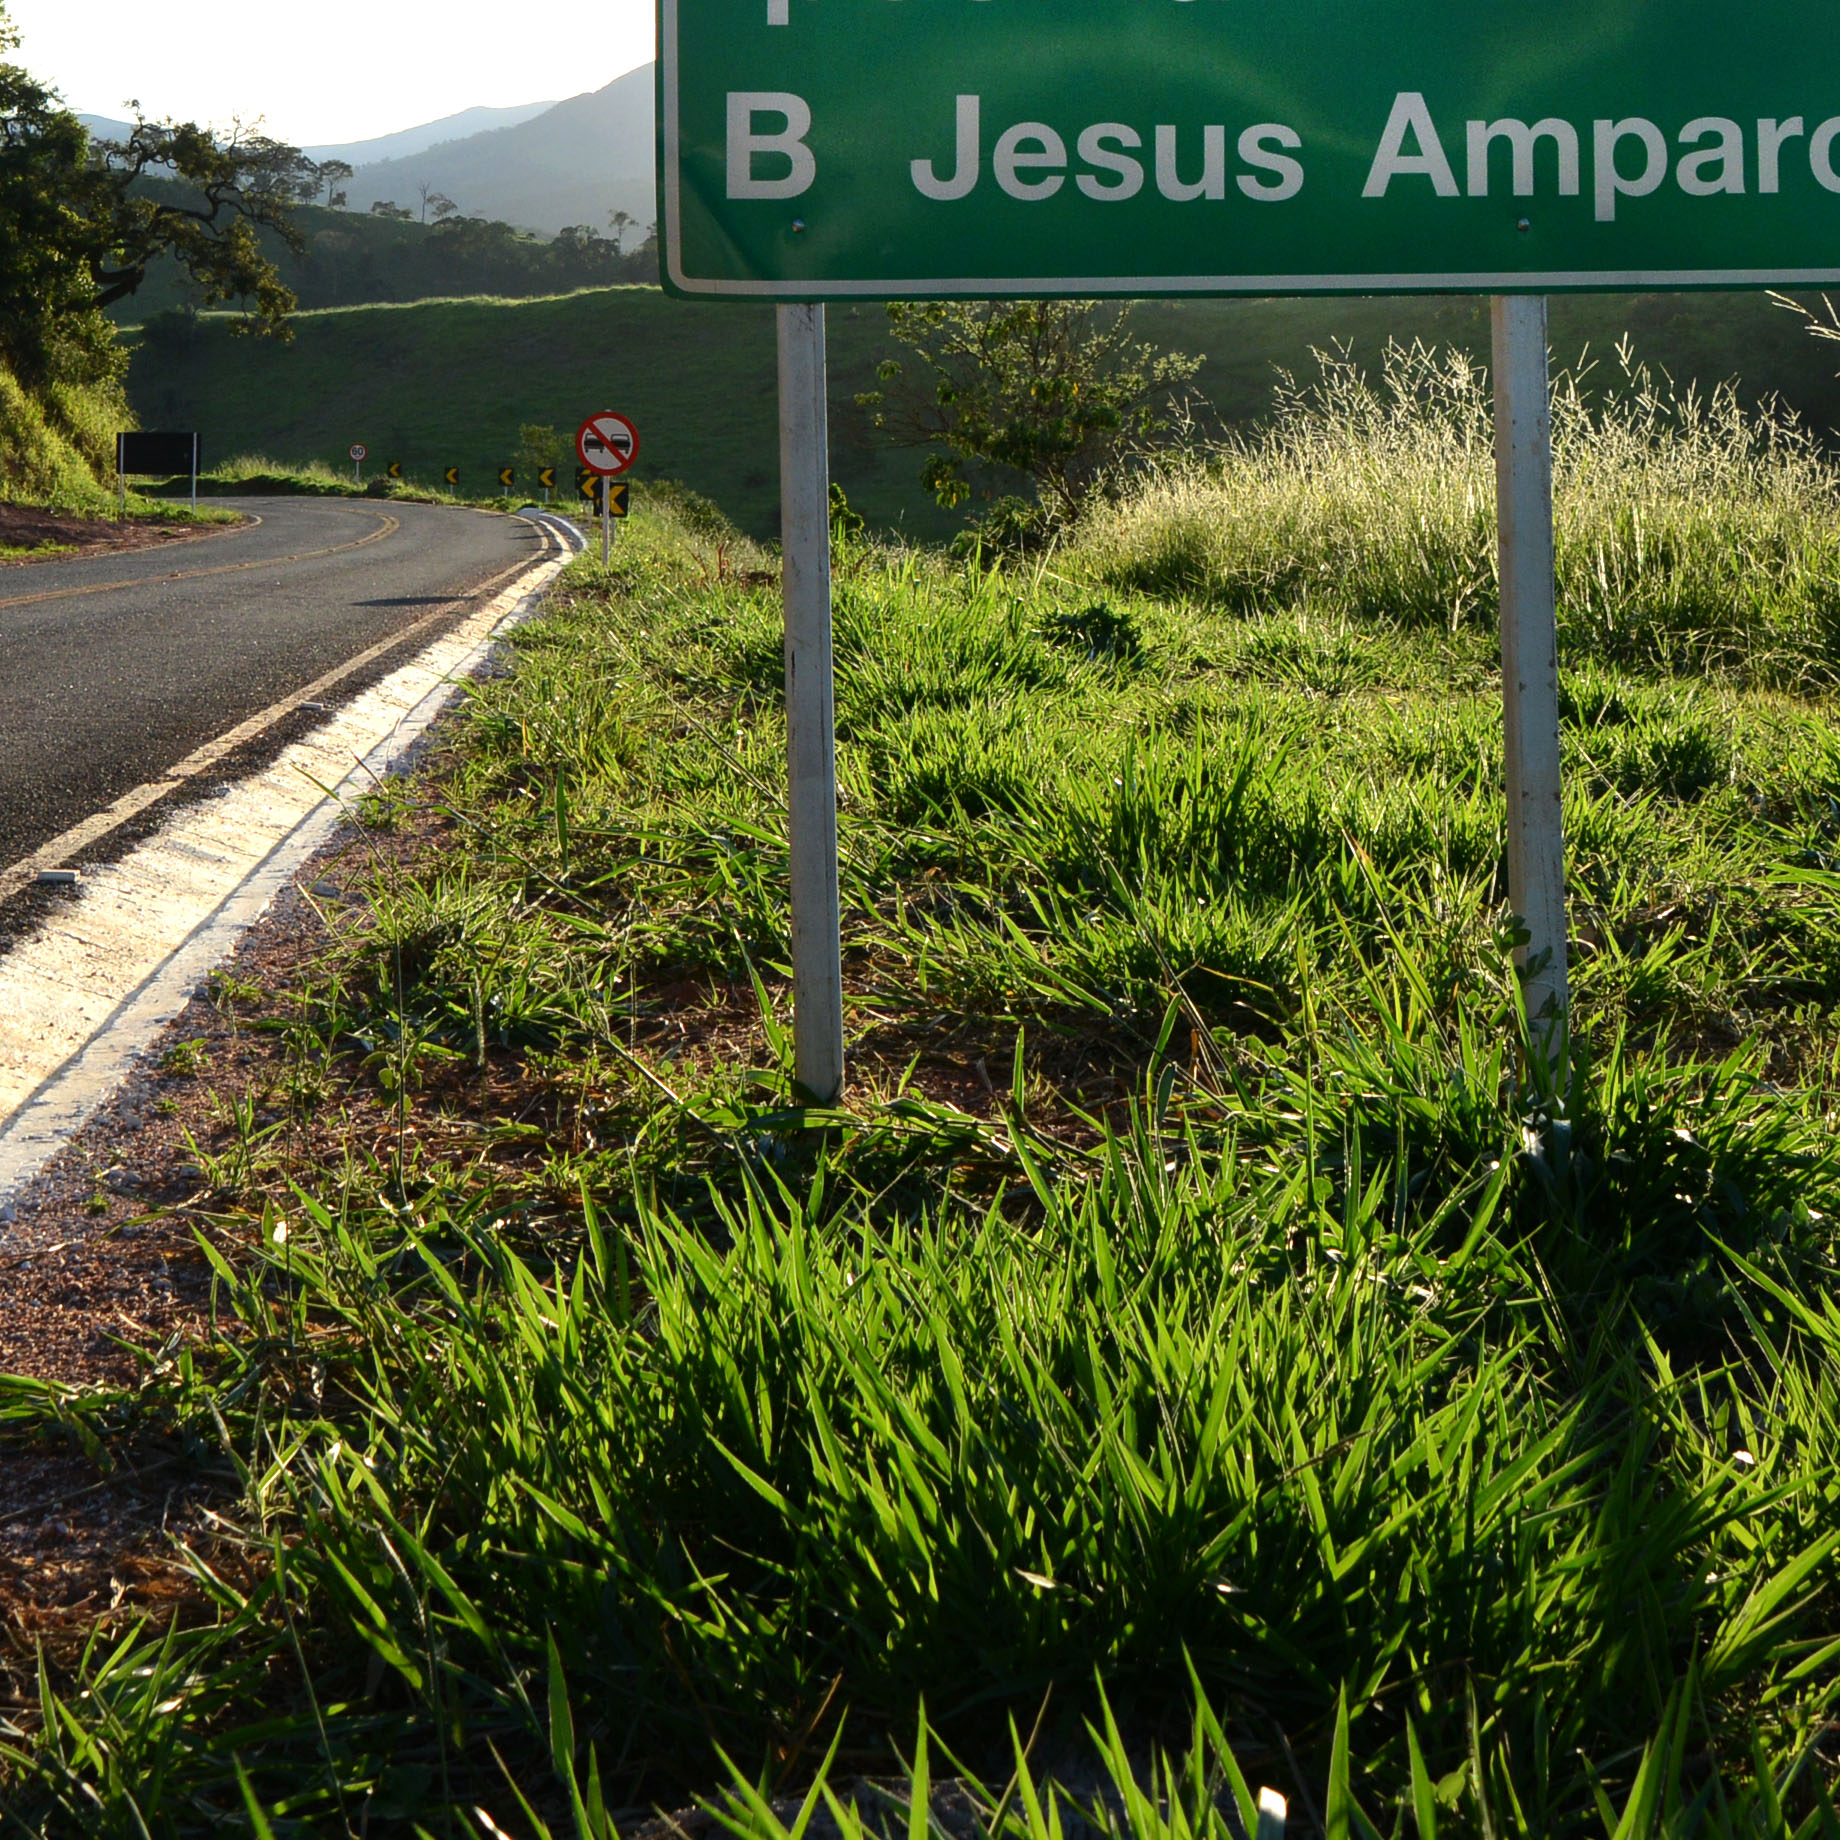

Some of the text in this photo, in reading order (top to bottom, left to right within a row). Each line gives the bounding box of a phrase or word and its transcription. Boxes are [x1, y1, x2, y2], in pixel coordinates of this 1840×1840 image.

[727, 93, 815, 198] B
[912, 95, 1303, 200] Jesus
[352, 447, 363, 456] 60
